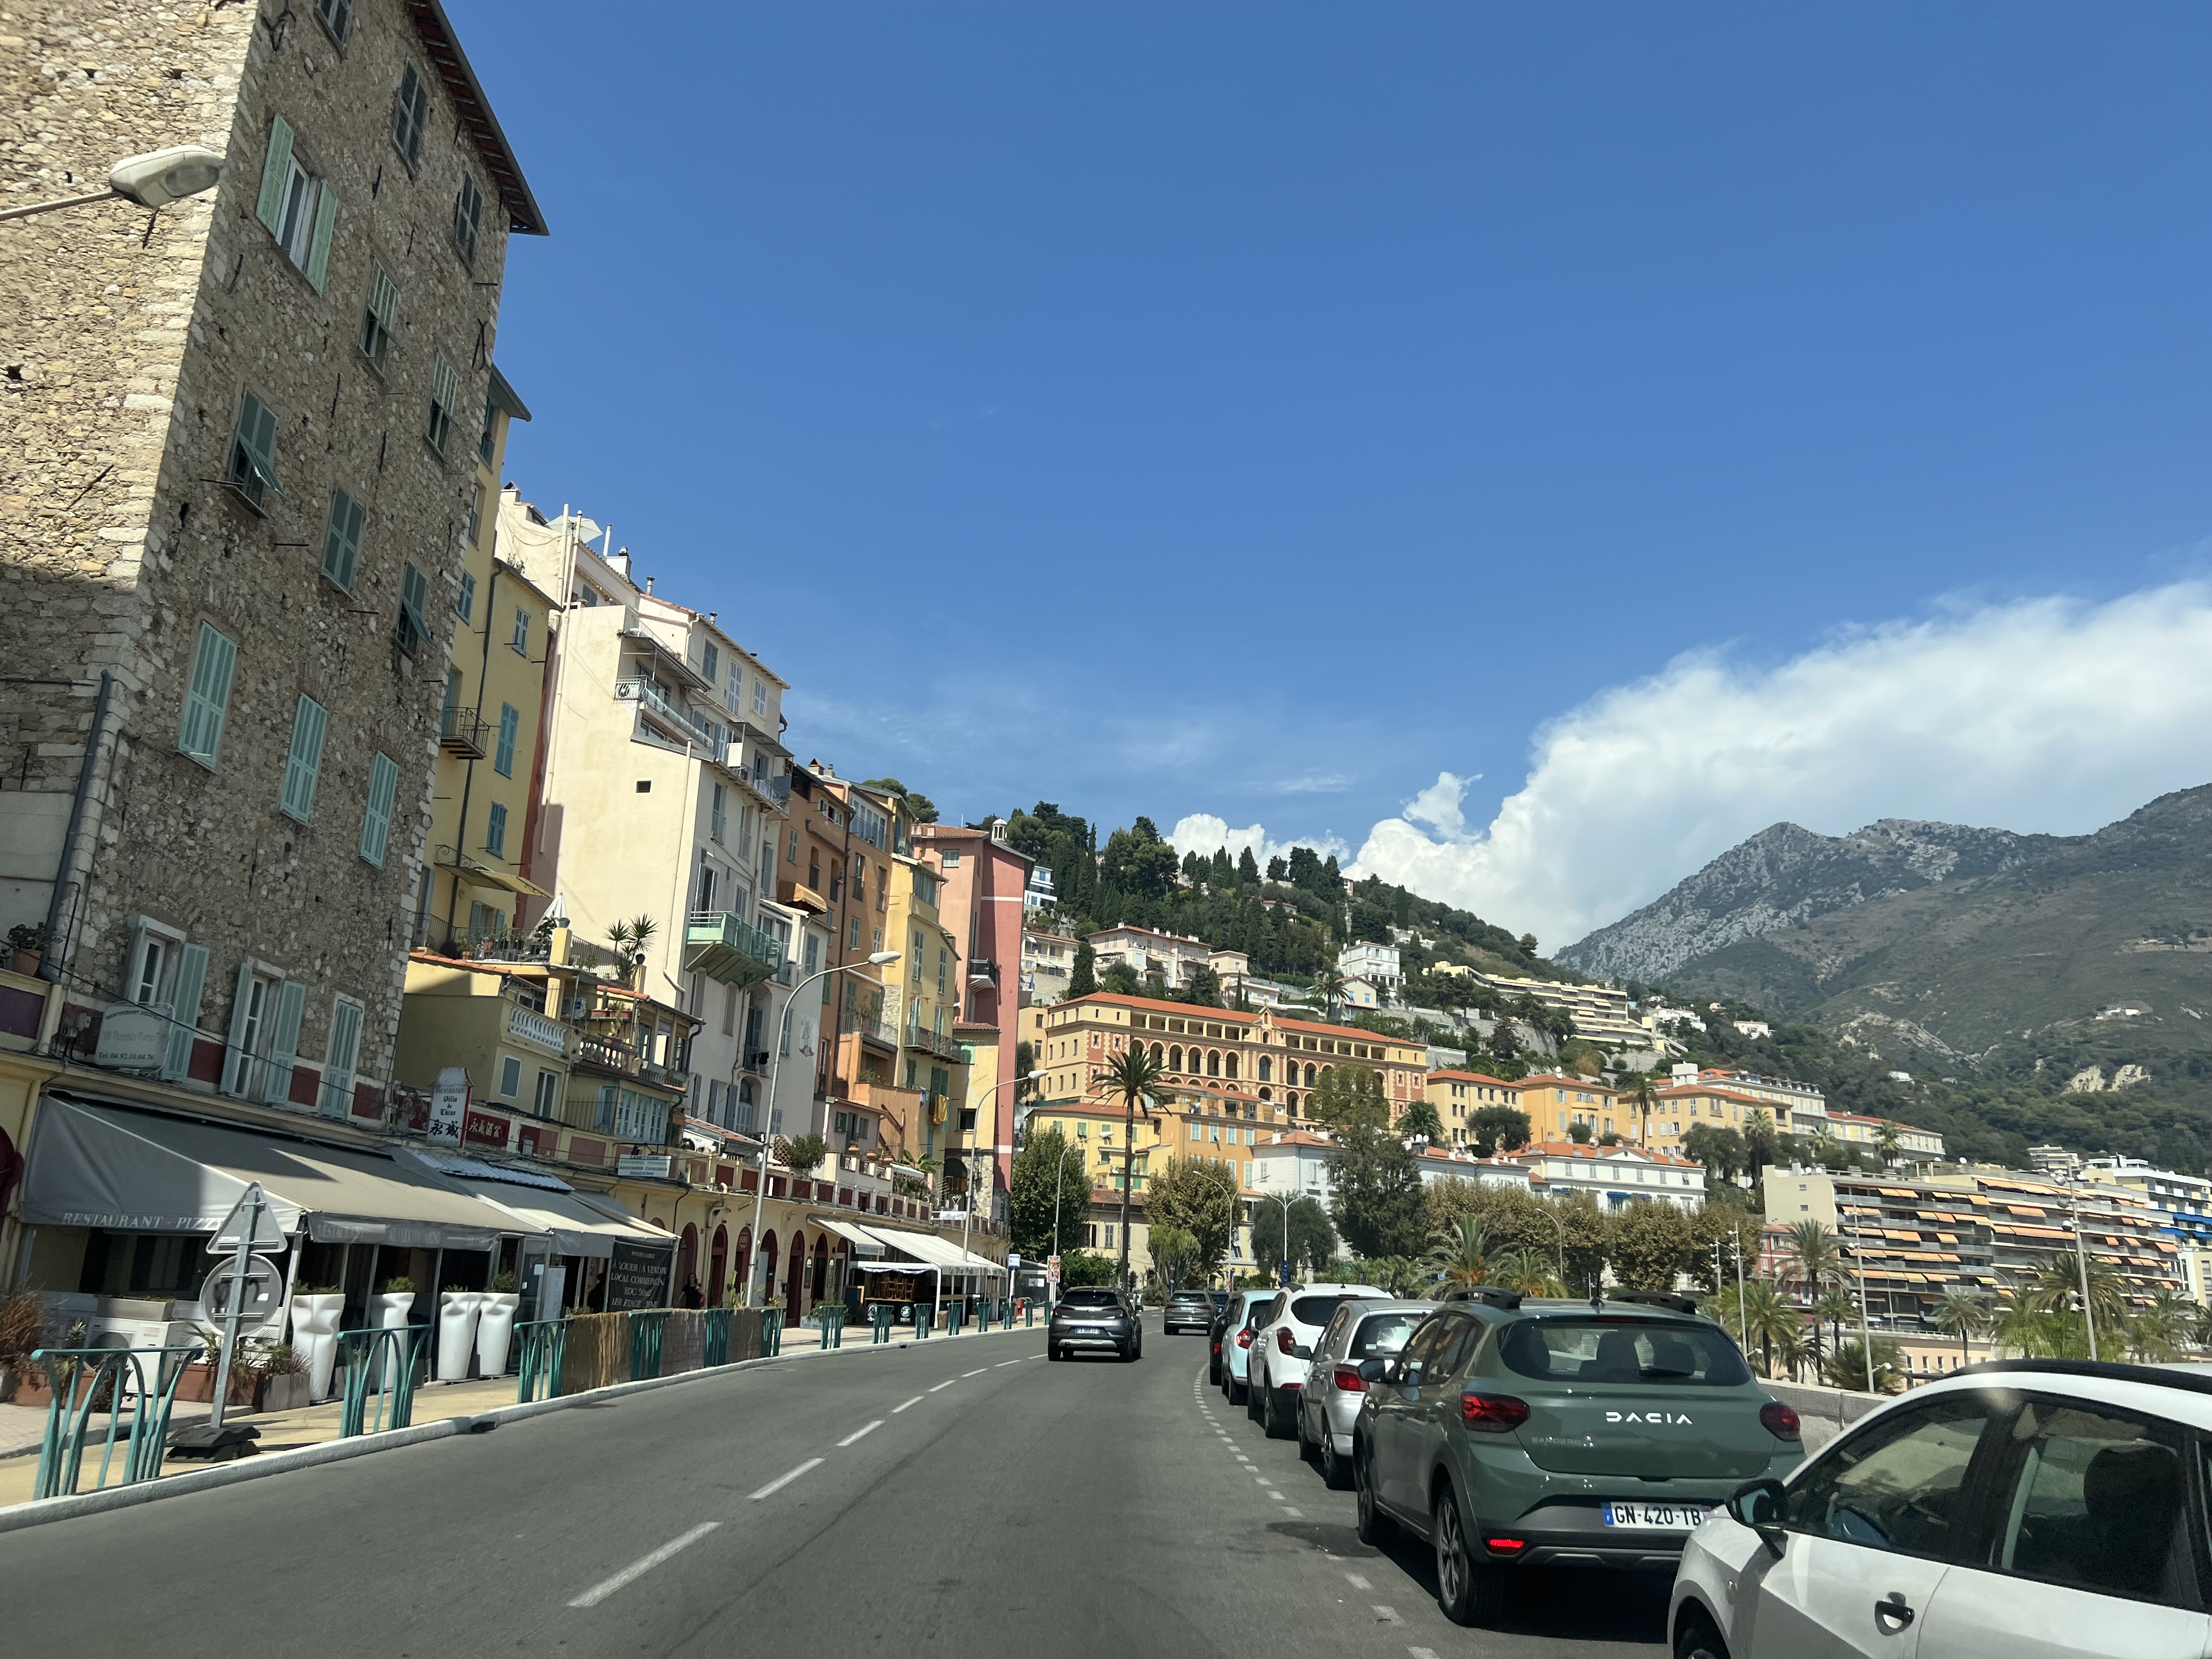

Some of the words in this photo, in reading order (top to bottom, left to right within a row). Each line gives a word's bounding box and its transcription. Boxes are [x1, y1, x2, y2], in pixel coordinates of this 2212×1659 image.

[61, 1212, 163, 1229] RESTAURANT
[619, 1262, 638, 1272] LOUER
[611, 1272, 629, 1283] LOCAL
[1605, 1412, 1693, 1425] DACIA
[1615, 1505, 1702, 1527] GN-420-TB
